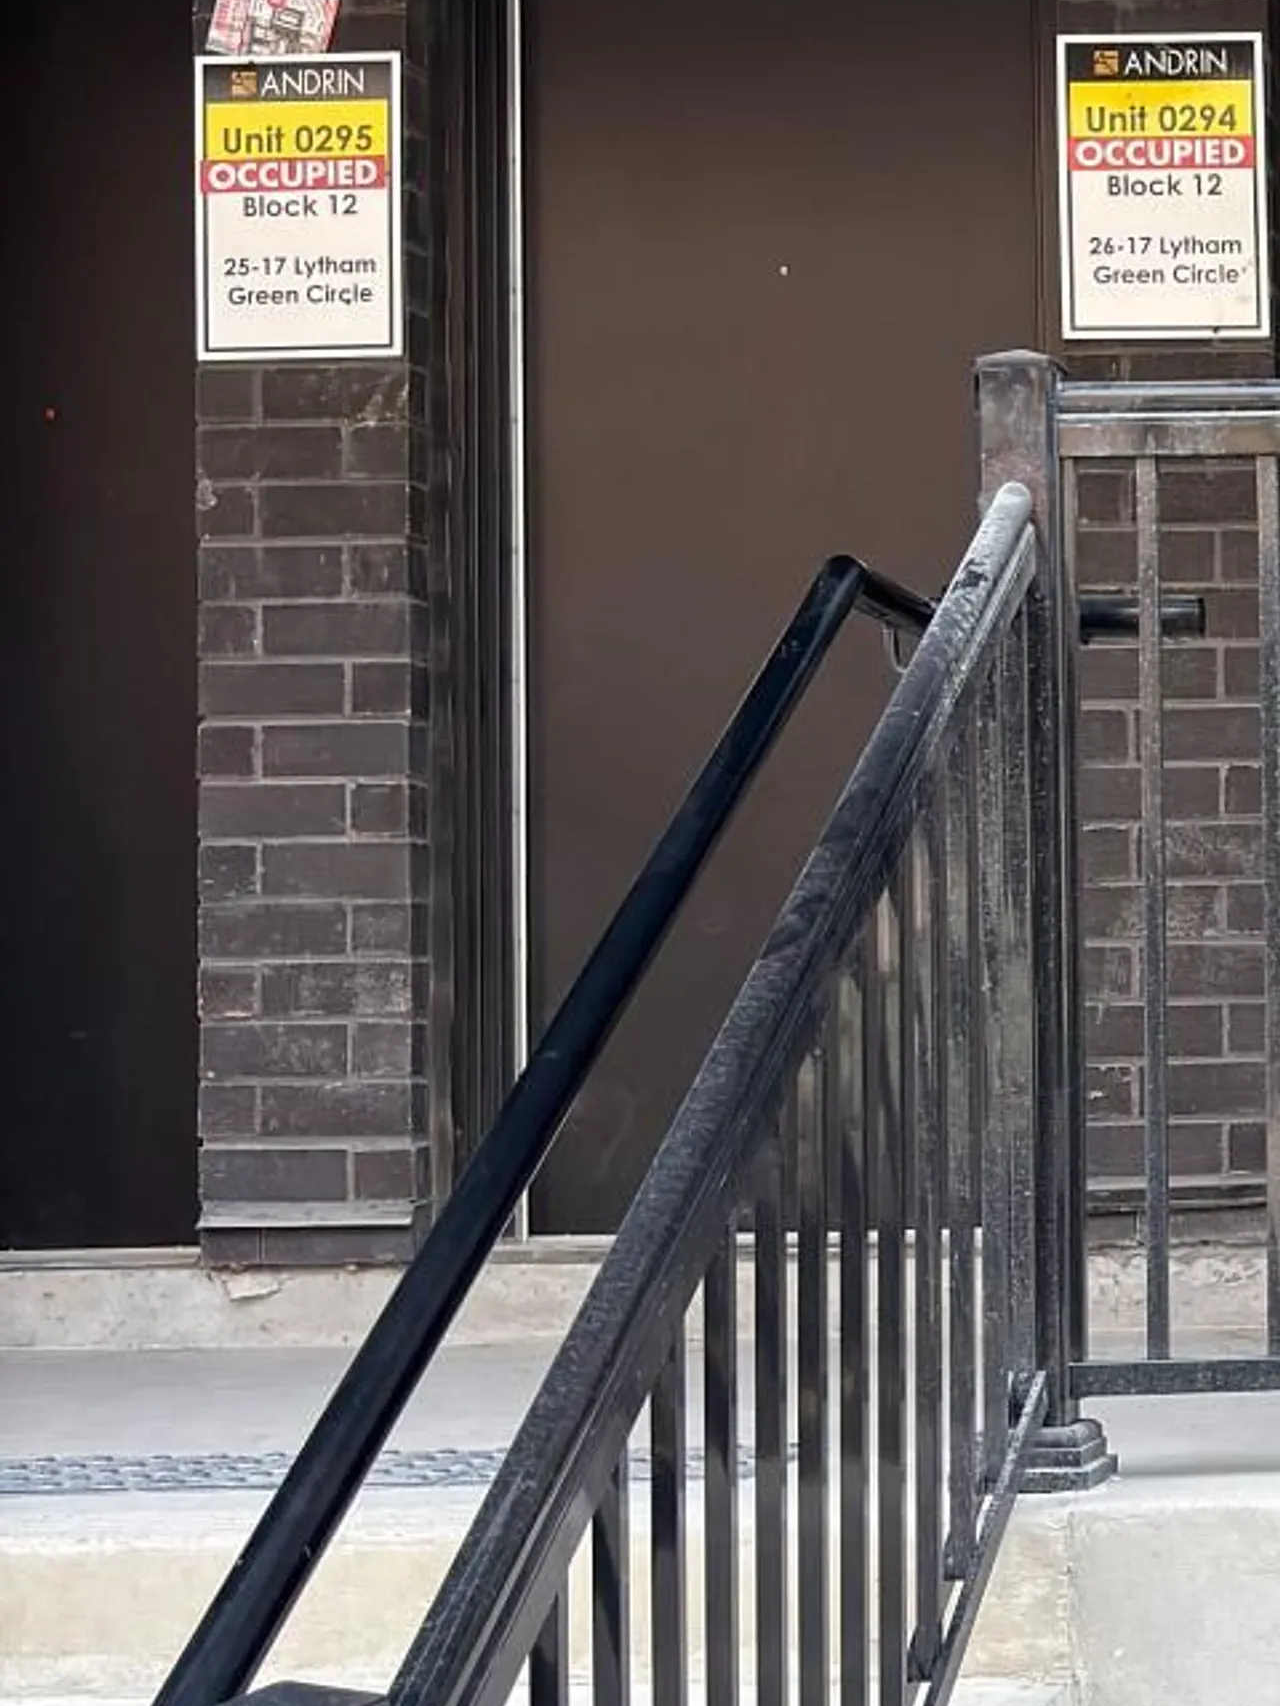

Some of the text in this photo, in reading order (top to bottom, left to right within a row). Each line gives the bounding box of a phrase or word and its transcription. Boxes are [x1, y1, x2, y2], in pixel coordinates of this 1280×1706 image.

[1124, 49, 1228, 76] ANDRIN
[262, 69, 364, 96] ANDRIN
[1086, 104, 1237, 132] Unit 0294
[223, 125, 373, 154] Unit 0295
[1076, 140, 1245, 167] OCCUPIED
[208, 159, 377, 190] OCCUPIED
[1108, 174, 1223, 196] Block 12
[243, 194, 358, 217] Block 12
[1089, 237, 1243, 259] 26-17 Lytham
[223, 255, 377, 278] 25-17 Lytham
[1093, 264, 1240, 285] Green Circle
[228, 283, 374, 305] Green Circle
